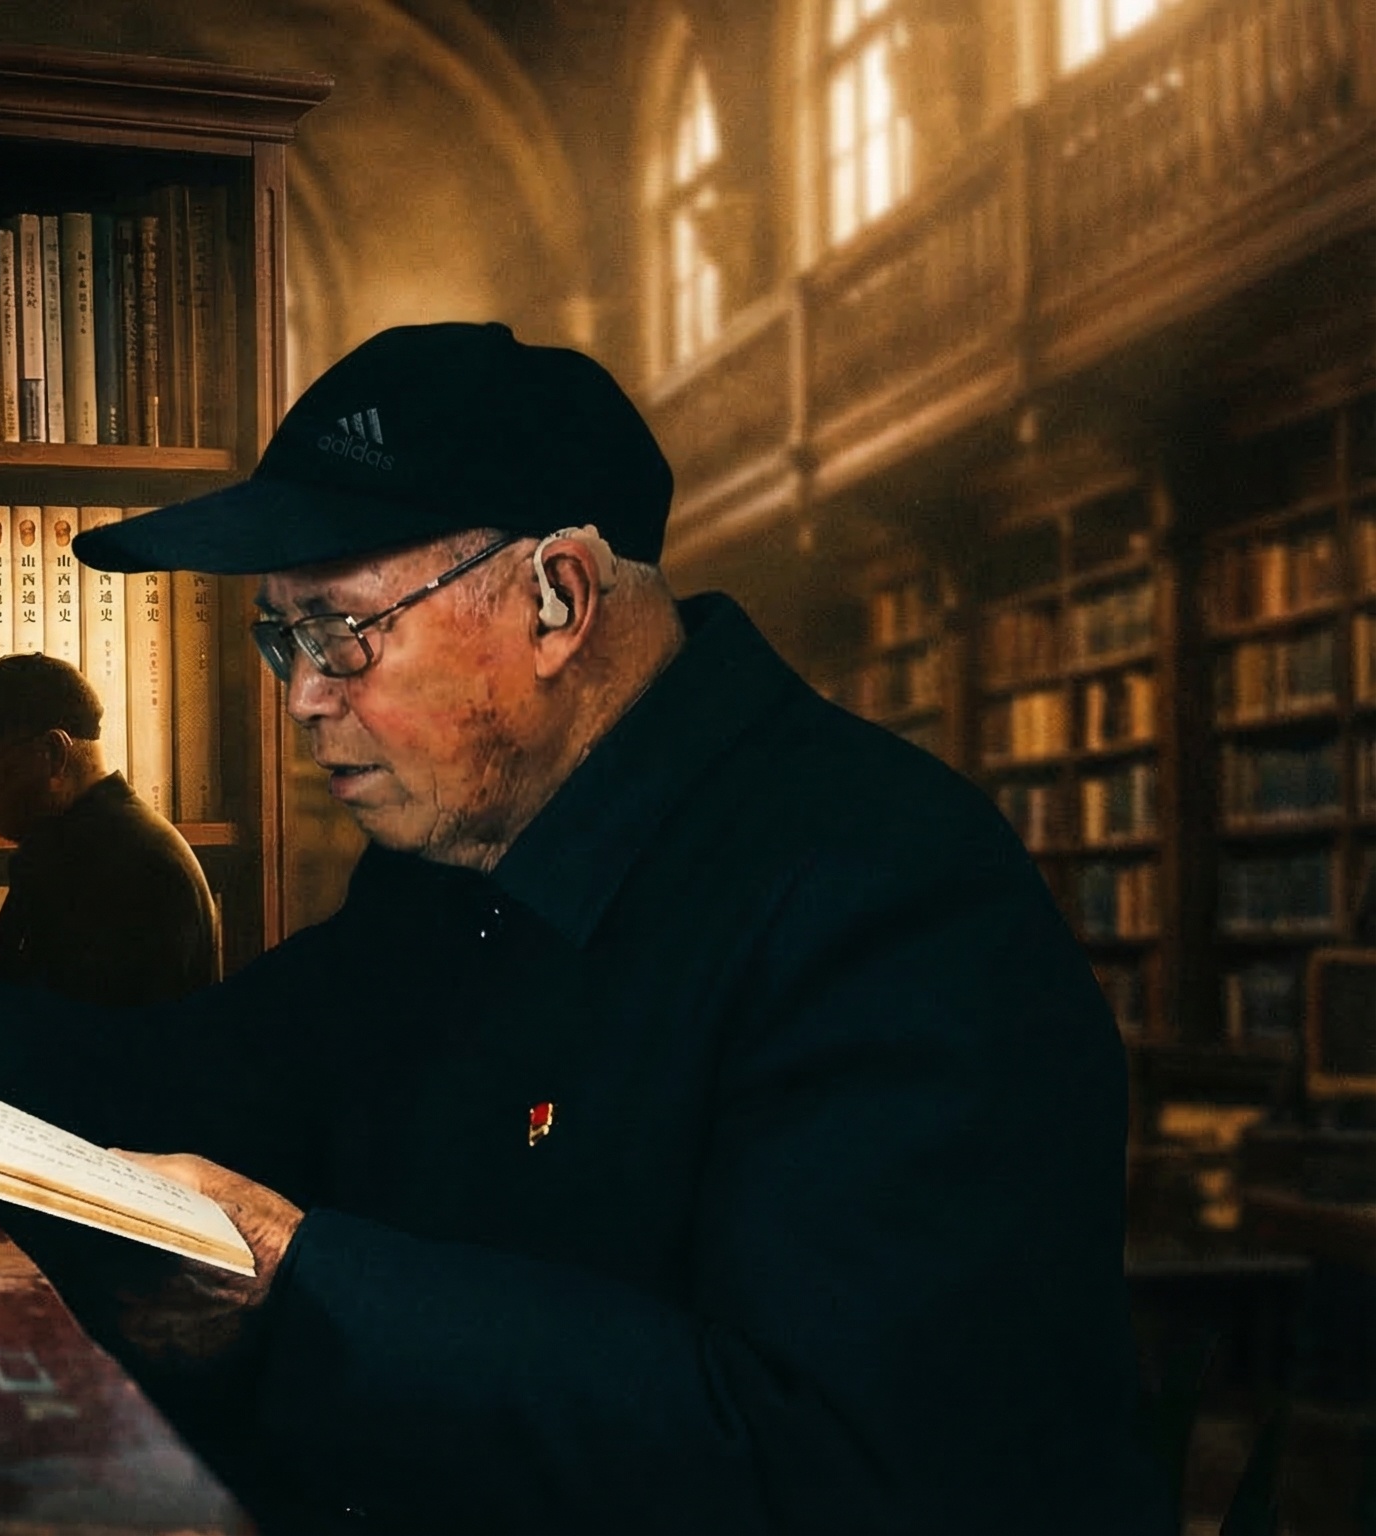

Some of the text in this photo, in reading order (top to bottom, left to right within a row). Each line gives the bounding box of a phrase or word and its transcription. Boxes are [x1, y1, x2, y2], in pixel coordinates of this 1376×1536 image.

[317, 433, 395, 471] adidas
[21, 554, 36, 623] 山西通史
[56, 554, 72, 623] 山西通史
[98, 574, 113, 622] 西通史
[145, 574, 159, 622] 西通史
